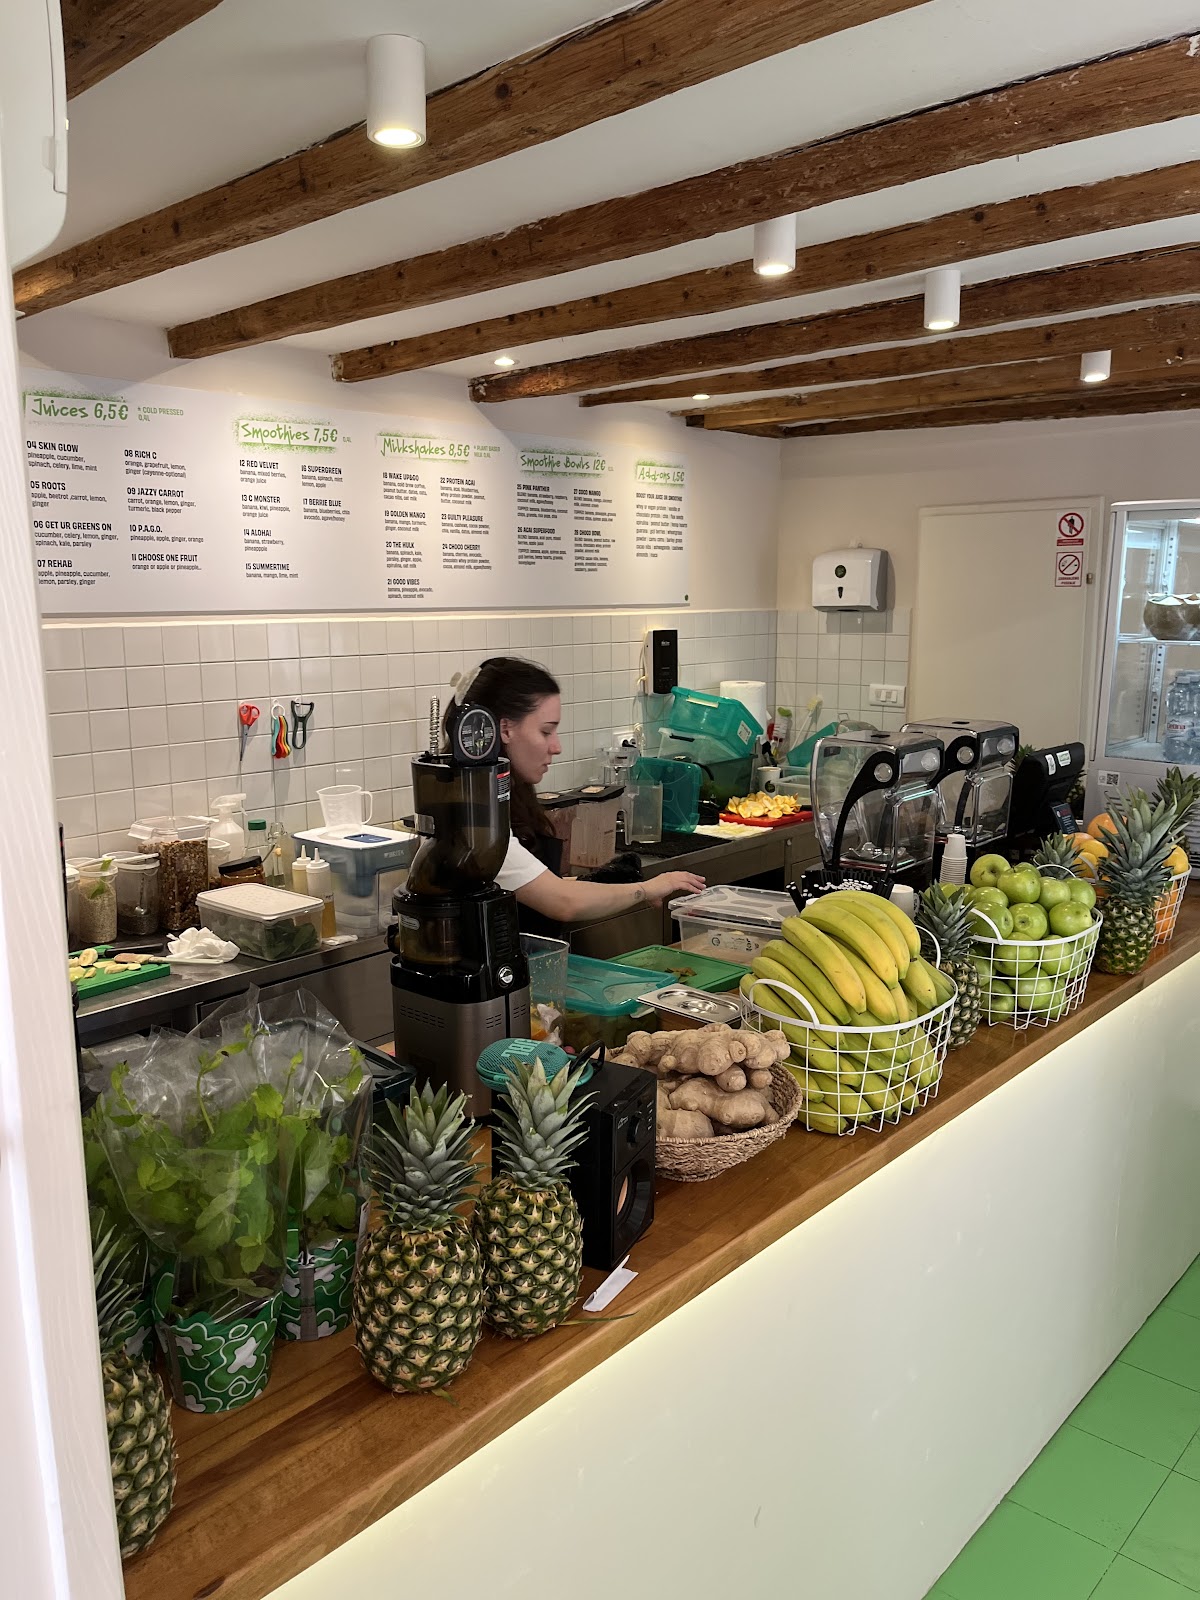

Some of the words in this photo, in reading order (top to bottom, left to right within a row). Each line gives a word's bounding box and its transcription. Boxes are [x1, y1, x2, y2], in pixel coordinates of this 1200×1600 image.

[32, 398, 89, 418] Juices
[94, 403, 128, 421] 6,5€
[159, 408, 183, 416] PRESSED
[241, 424, 309, 445] Smoothies
[314, 428, 338, 443] 7,5€
[27, 440, 36, 449] 04
[38, 441, 56, 450] SKIN
[58, 443, 78, 452] GLOW
[381, 438, 446, 459] Milkshakes
[448, 443, 470, 457] 8,5€
[28, 452, 56, 460] pineapple,
[125, 449, 133, 457] 08
[134, 450, 150, 459] RICH
[152, 451, 156, 459] C
[29, 460, 52, 468] spinach,
[52, 462, 70, 470] celery,
[259, 461, 278, 469] VELVET
[521, 455, 560, 472] Smoothie
[564, 456, 590, 469] Bowls
[307, 465, 341, 474] SUPERGREEN
[30, 480, 39, 488] 05
[41, 481, 65, 490] ROOTS
[127, 487, 135, 495] 09
[137, 487, 156, 496] JAZZY
[158, 489, 183, 497] CARROT
[32, 500, 49, 508] ginger
[253, 495, 280, 503] MONSTER
[308, 498, 327, 506] BERRIE
[328, 499, 341, 507] BLUE
[34, 520, 43, 528] 06
[45, 521, 58, 529] GET
[60, 521, 70, 529] UR
[72, 522, 100, 530] GREENS
[101, 523, 111, 531] ON
[130, 524, 136, 532] 10
[138, 524, 162, 533] P.A.G.O.
[132, 553, 136, 561] 11
[138, 553, 164, 561] CHOOSE
[37, 559, 45, 567] 07
[47, 559, 72, 567] REHAB
[501, 1039, 541, 1057] JBL
